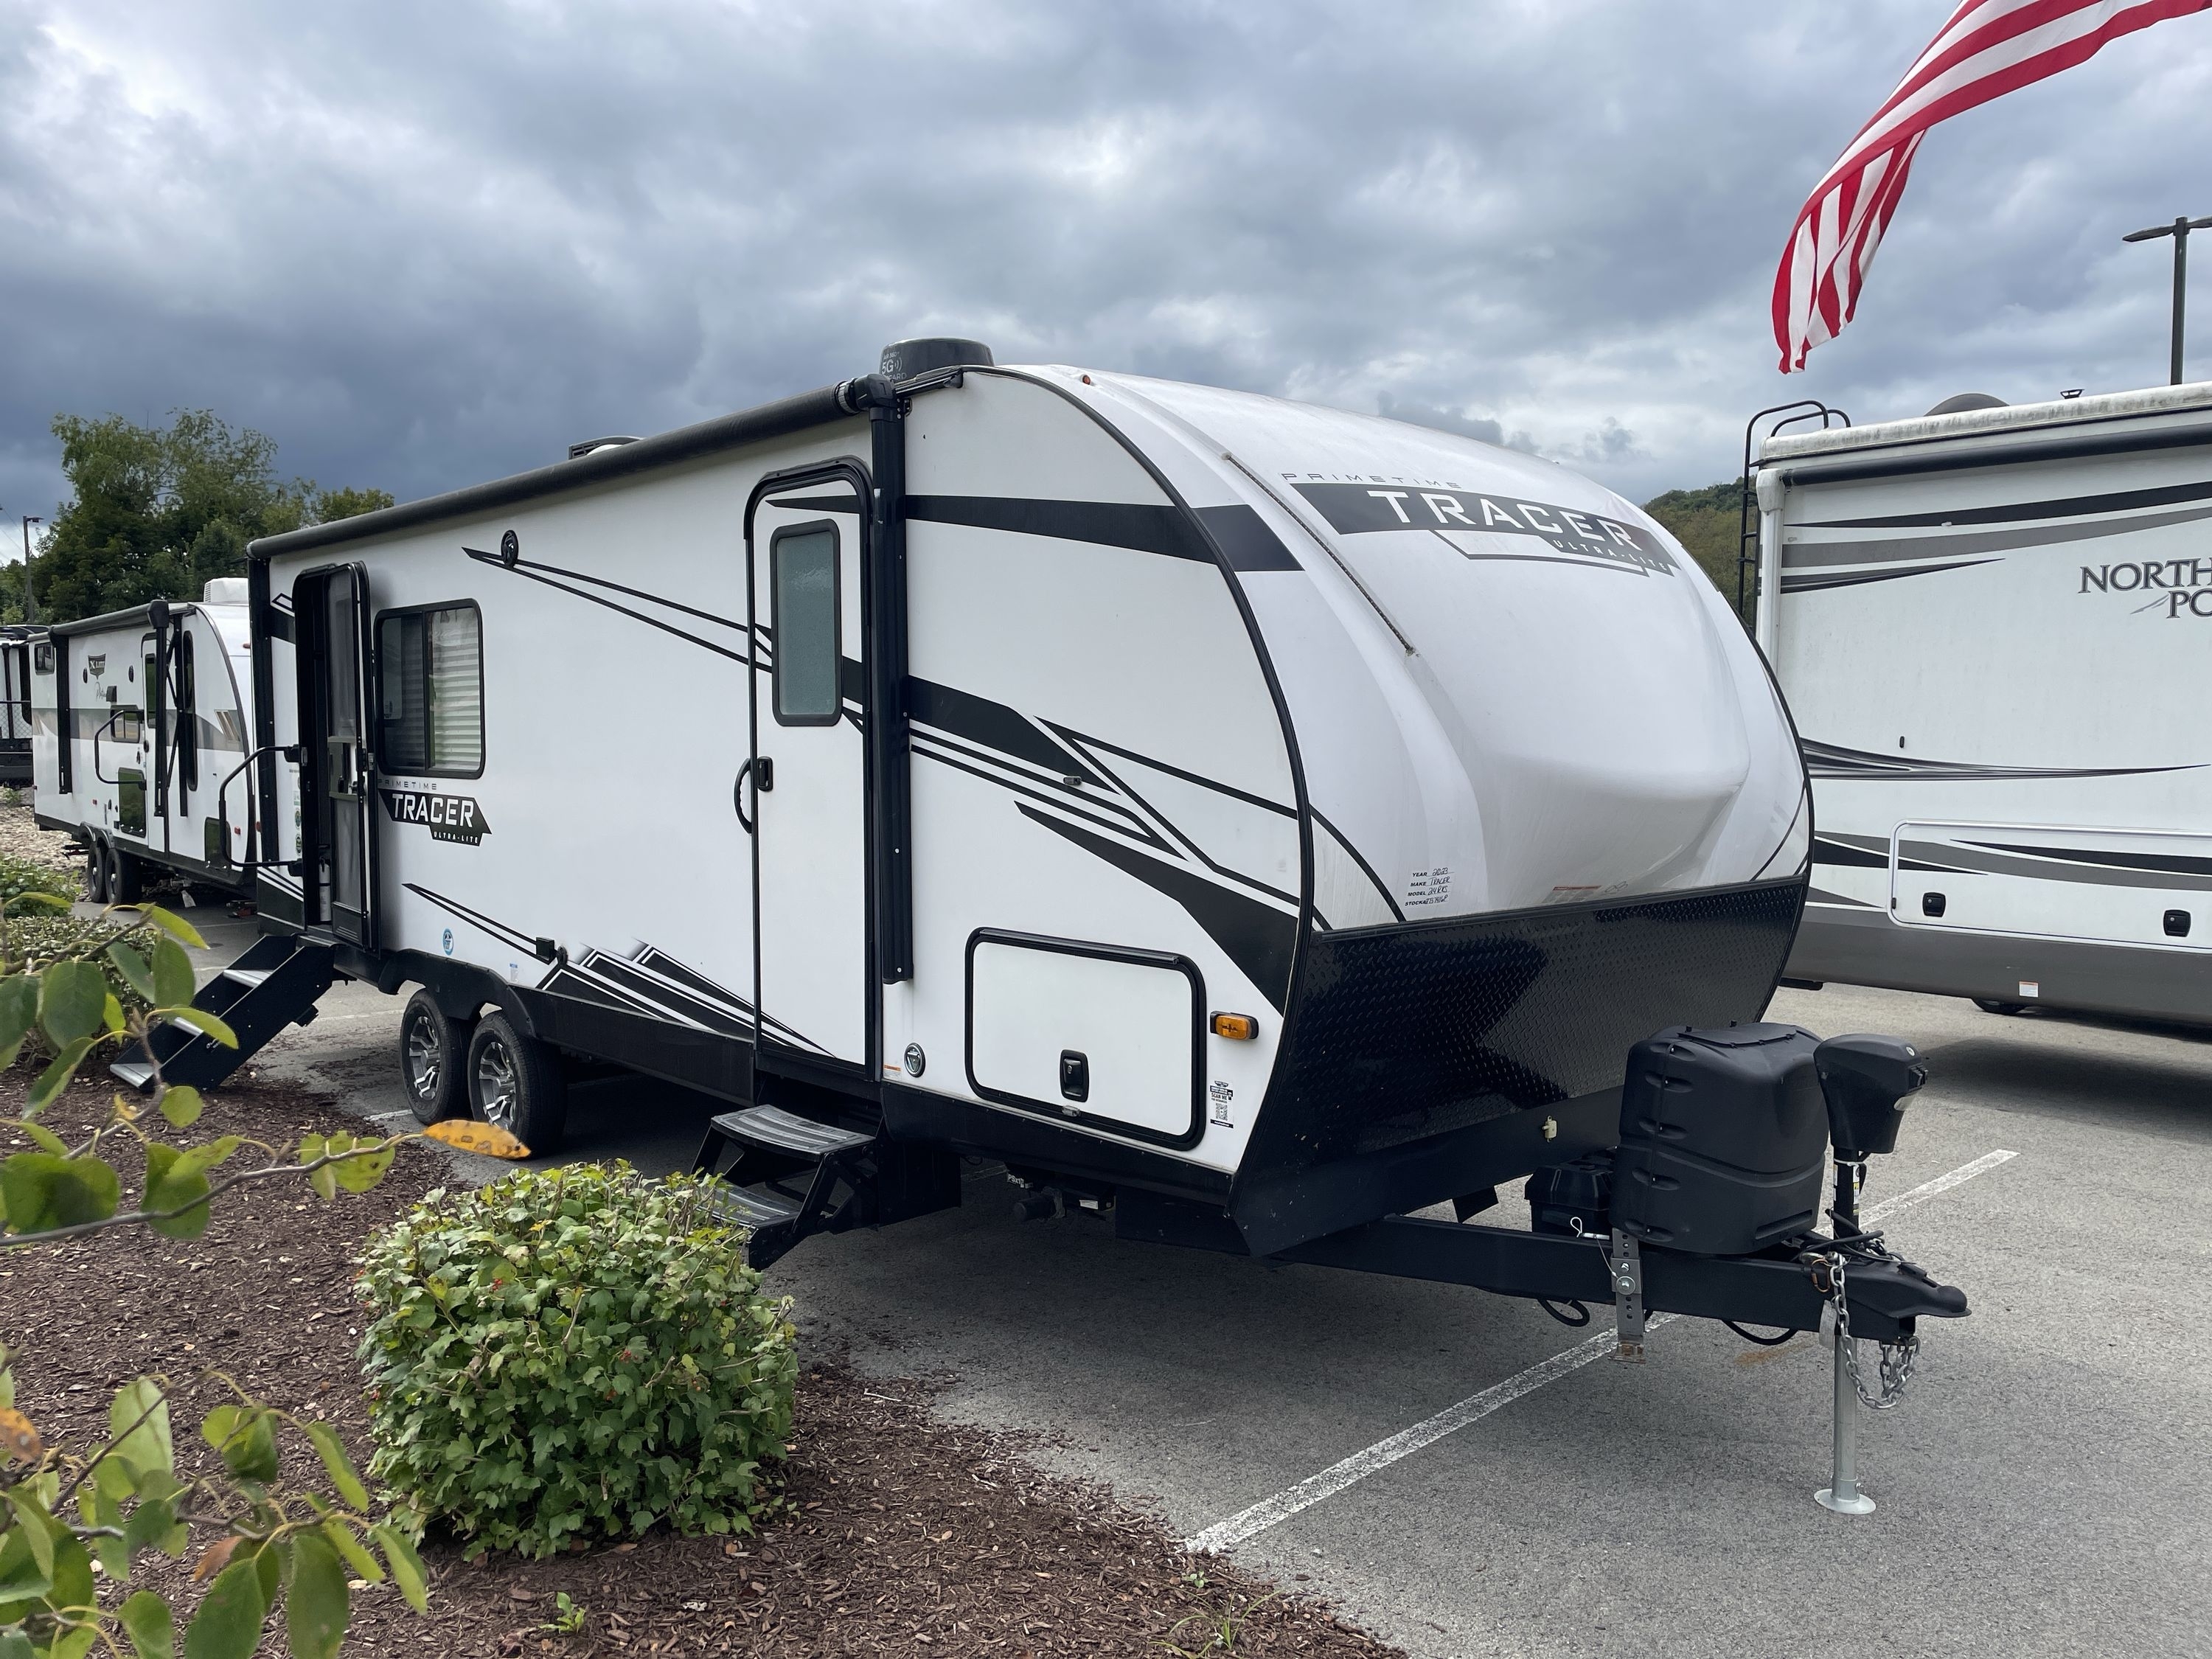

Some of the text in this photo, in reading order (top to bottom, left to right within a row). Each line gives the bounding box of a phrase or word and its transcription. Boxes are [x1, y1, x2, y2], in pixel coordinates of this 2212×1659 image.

[881, 359, 894, 375] 5G
[1281, 473, 1462, 489] PRIMETIME
[1367, 490, 1644, 552] TRACER
[1553, 539, 1667, 571] ULTRA-LITE
[2078, 557, 2212, 594] NORTH
[378, 779, 437, 790] PRIMETIME
[392, 793, 474, 828] TRACER
[434, 831, 478, 844] ULTRA-LITE
